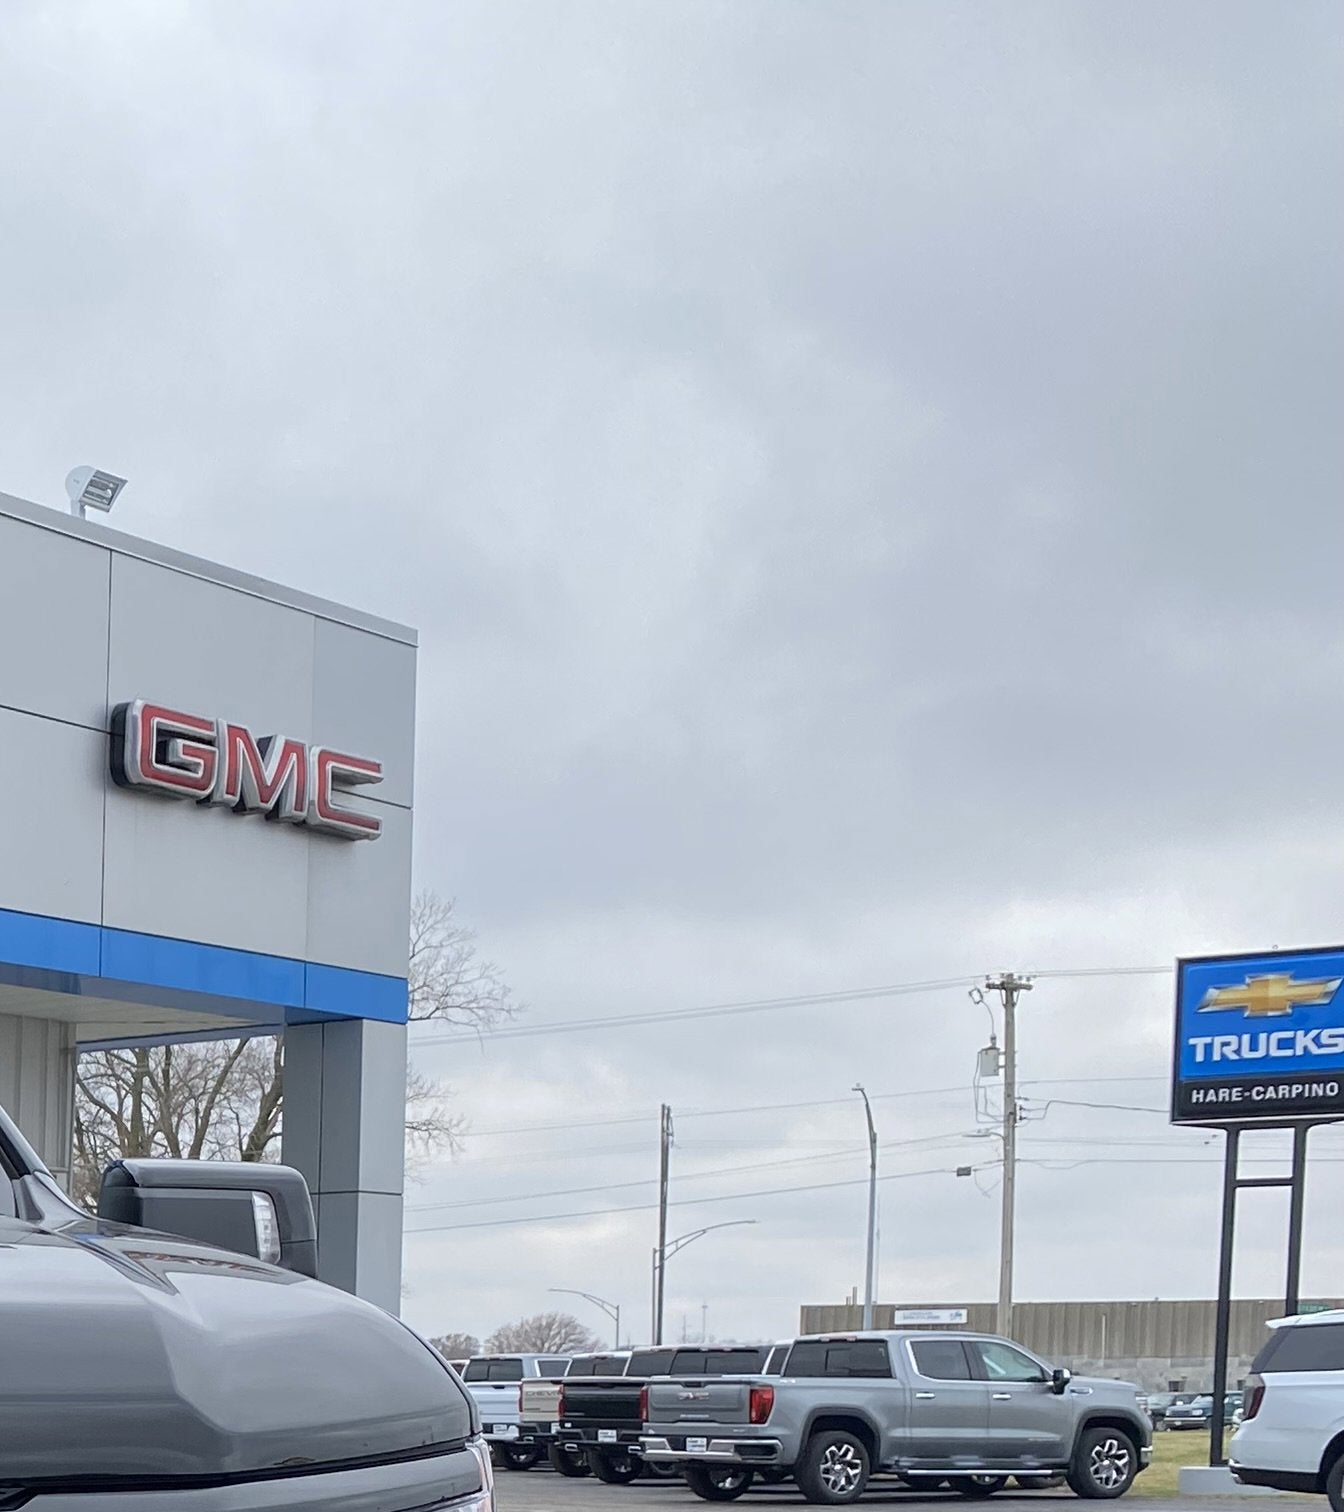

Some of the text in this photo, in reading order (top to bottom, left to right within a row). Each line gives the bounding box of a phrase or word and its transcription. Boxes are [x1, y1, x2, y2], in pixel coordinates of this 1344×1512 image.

[110, 697, 385, 842] GMC
[1189, 1028, 1344, 1062] TRUCKS
[1192, 1082, 1339, 1103] HARE-CARPINO
